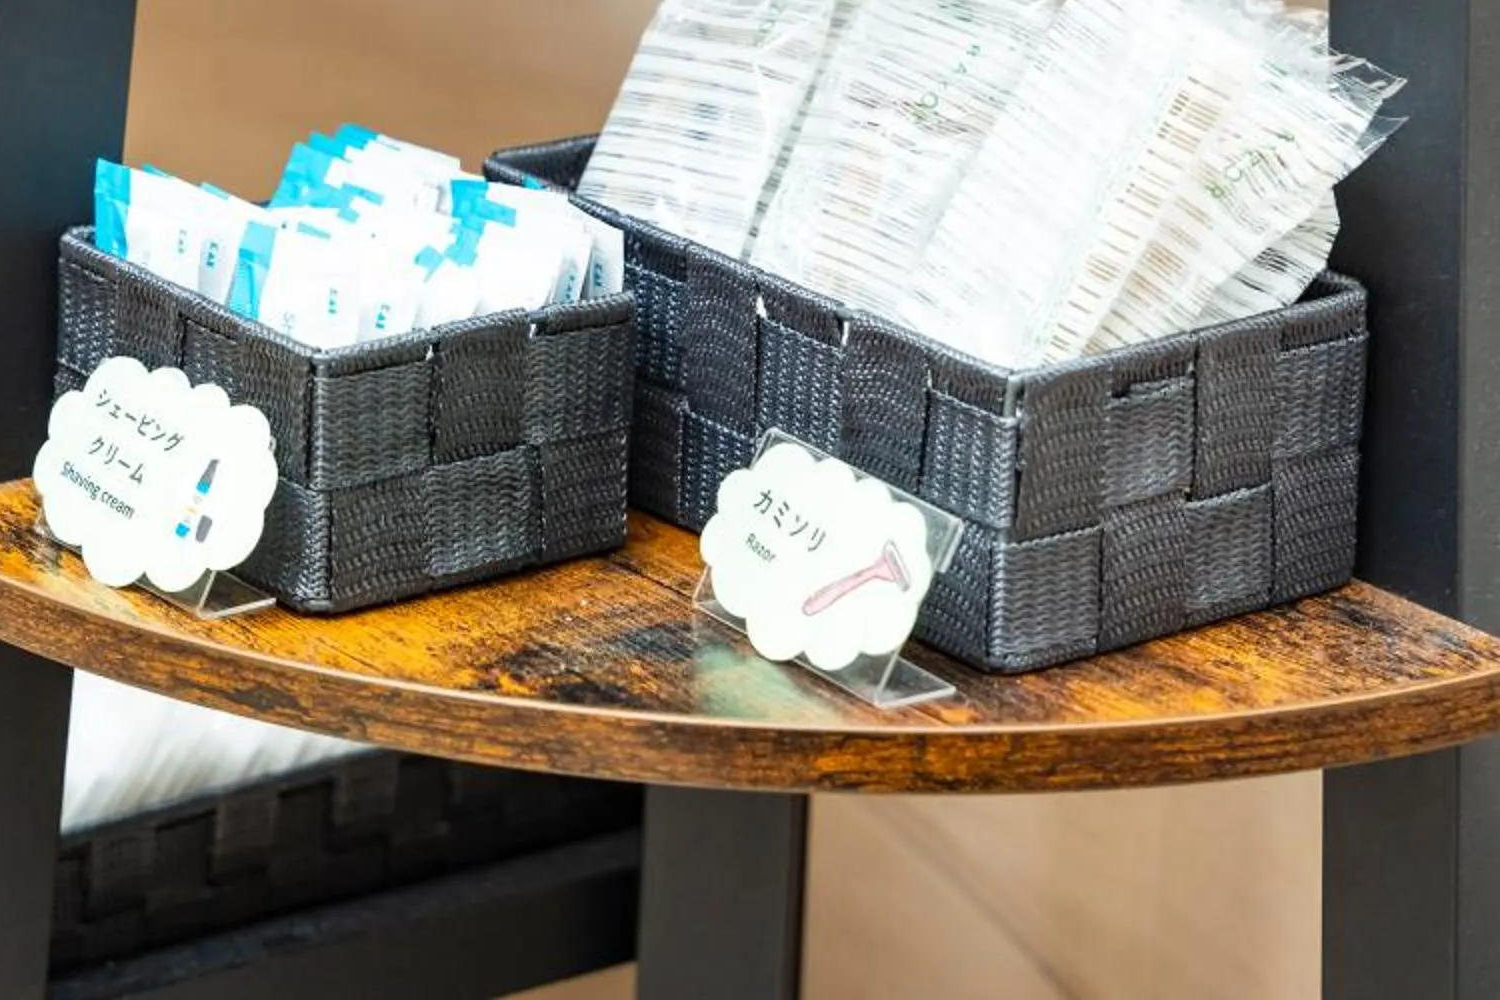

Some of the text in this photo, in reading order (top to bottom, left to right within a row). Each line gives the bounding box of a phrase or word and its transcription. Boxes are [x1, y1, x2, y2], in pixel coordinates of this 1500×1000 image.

[96, 389, 184, 451] シェービング
[88, 436, 143, 484] クリーム
[60, 461, 136, 519] Shaving cream
[745, 533, 777, 562] Razor
[753, 489, 825, 550] カミソリ
